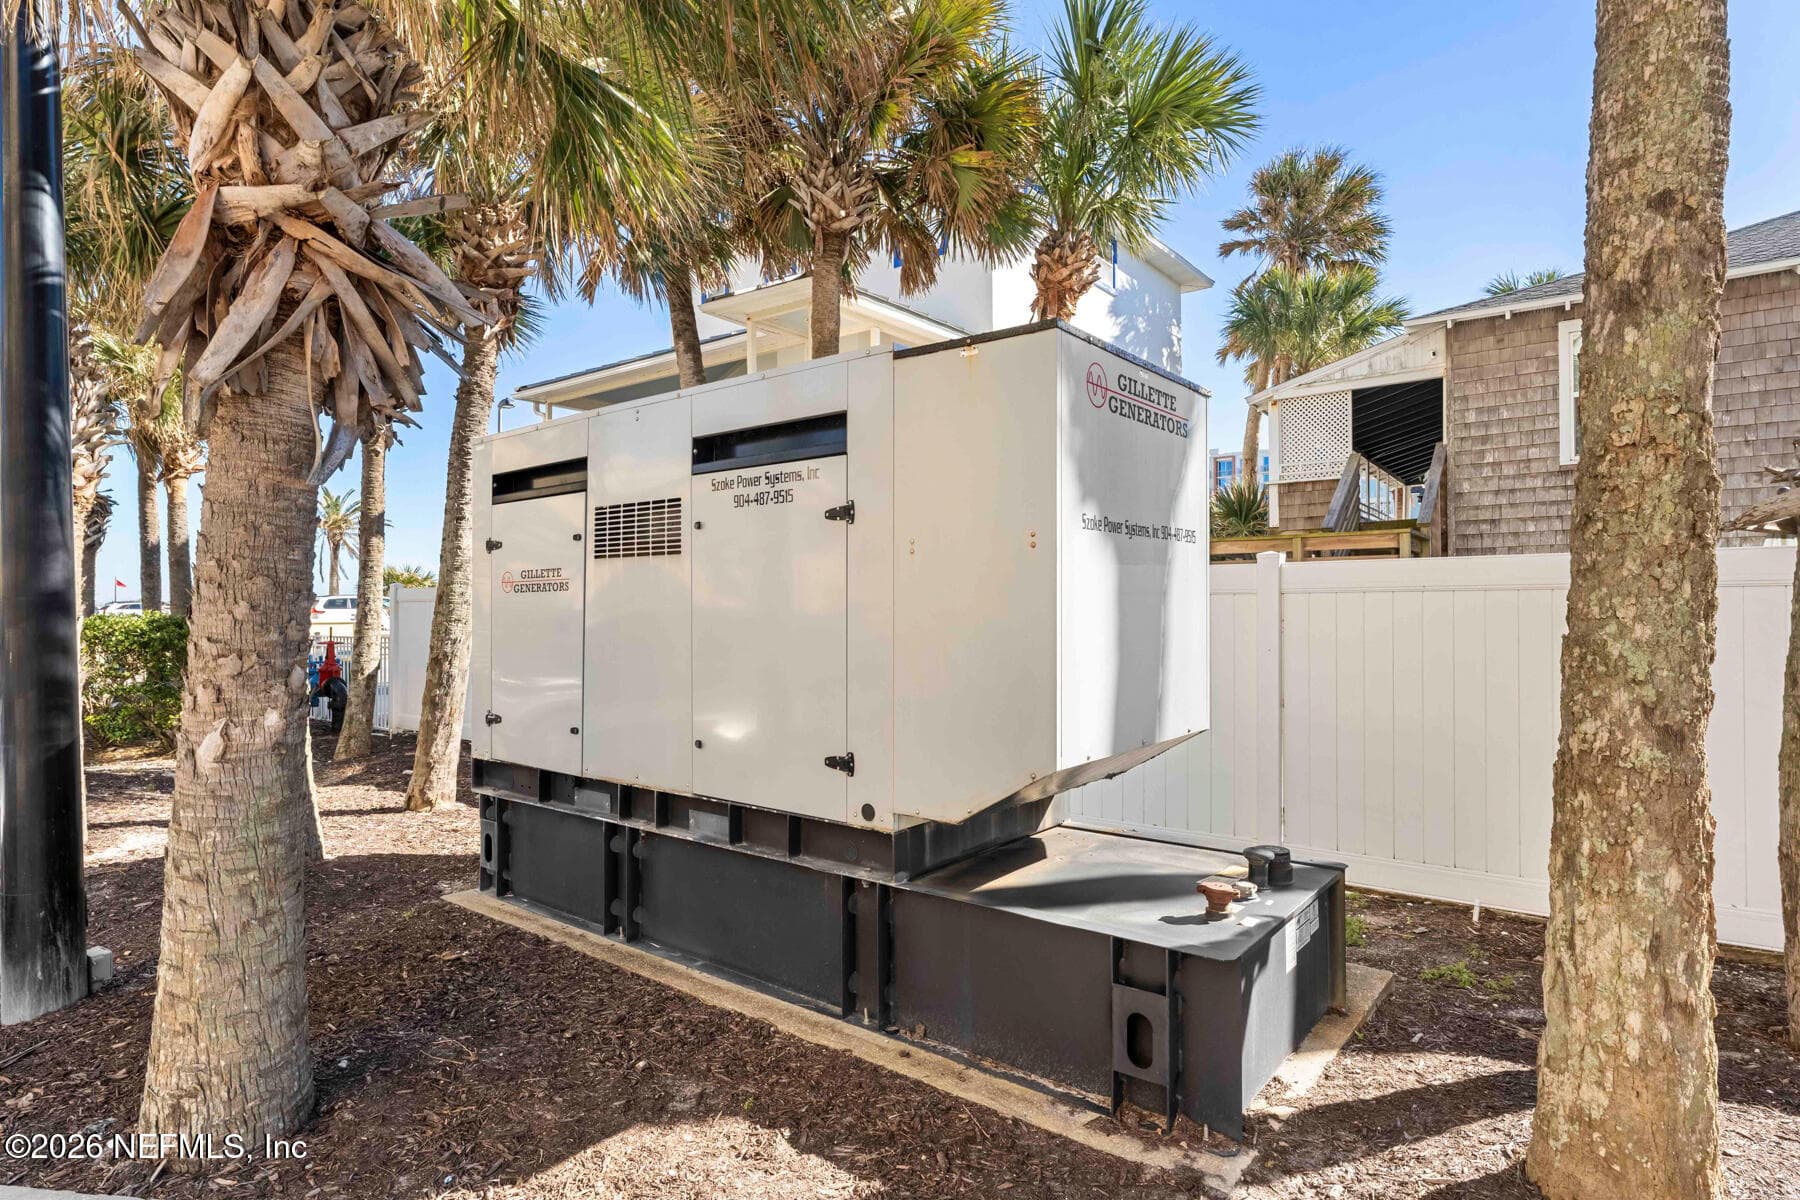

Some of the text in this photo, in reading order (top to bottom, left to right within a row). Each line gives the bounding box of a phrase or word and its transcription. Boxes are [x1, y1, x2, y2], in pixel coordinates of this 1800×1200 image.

[1117, 373, 1177, 412] GILLETTE
[1108, 395, 1188, 438] GENERATORS
[711, 477, 735, 492] Szoke
[737, 475, 762, 488] Power
[764, 470, 805, 488] Systems,
[1081, 513, 1103, 531] Szoke
[1103, 516, 1123, 534] Power
[520, 568, 562, 579] GILLETTE
[513, 582, 569, 593] GENERATORS
